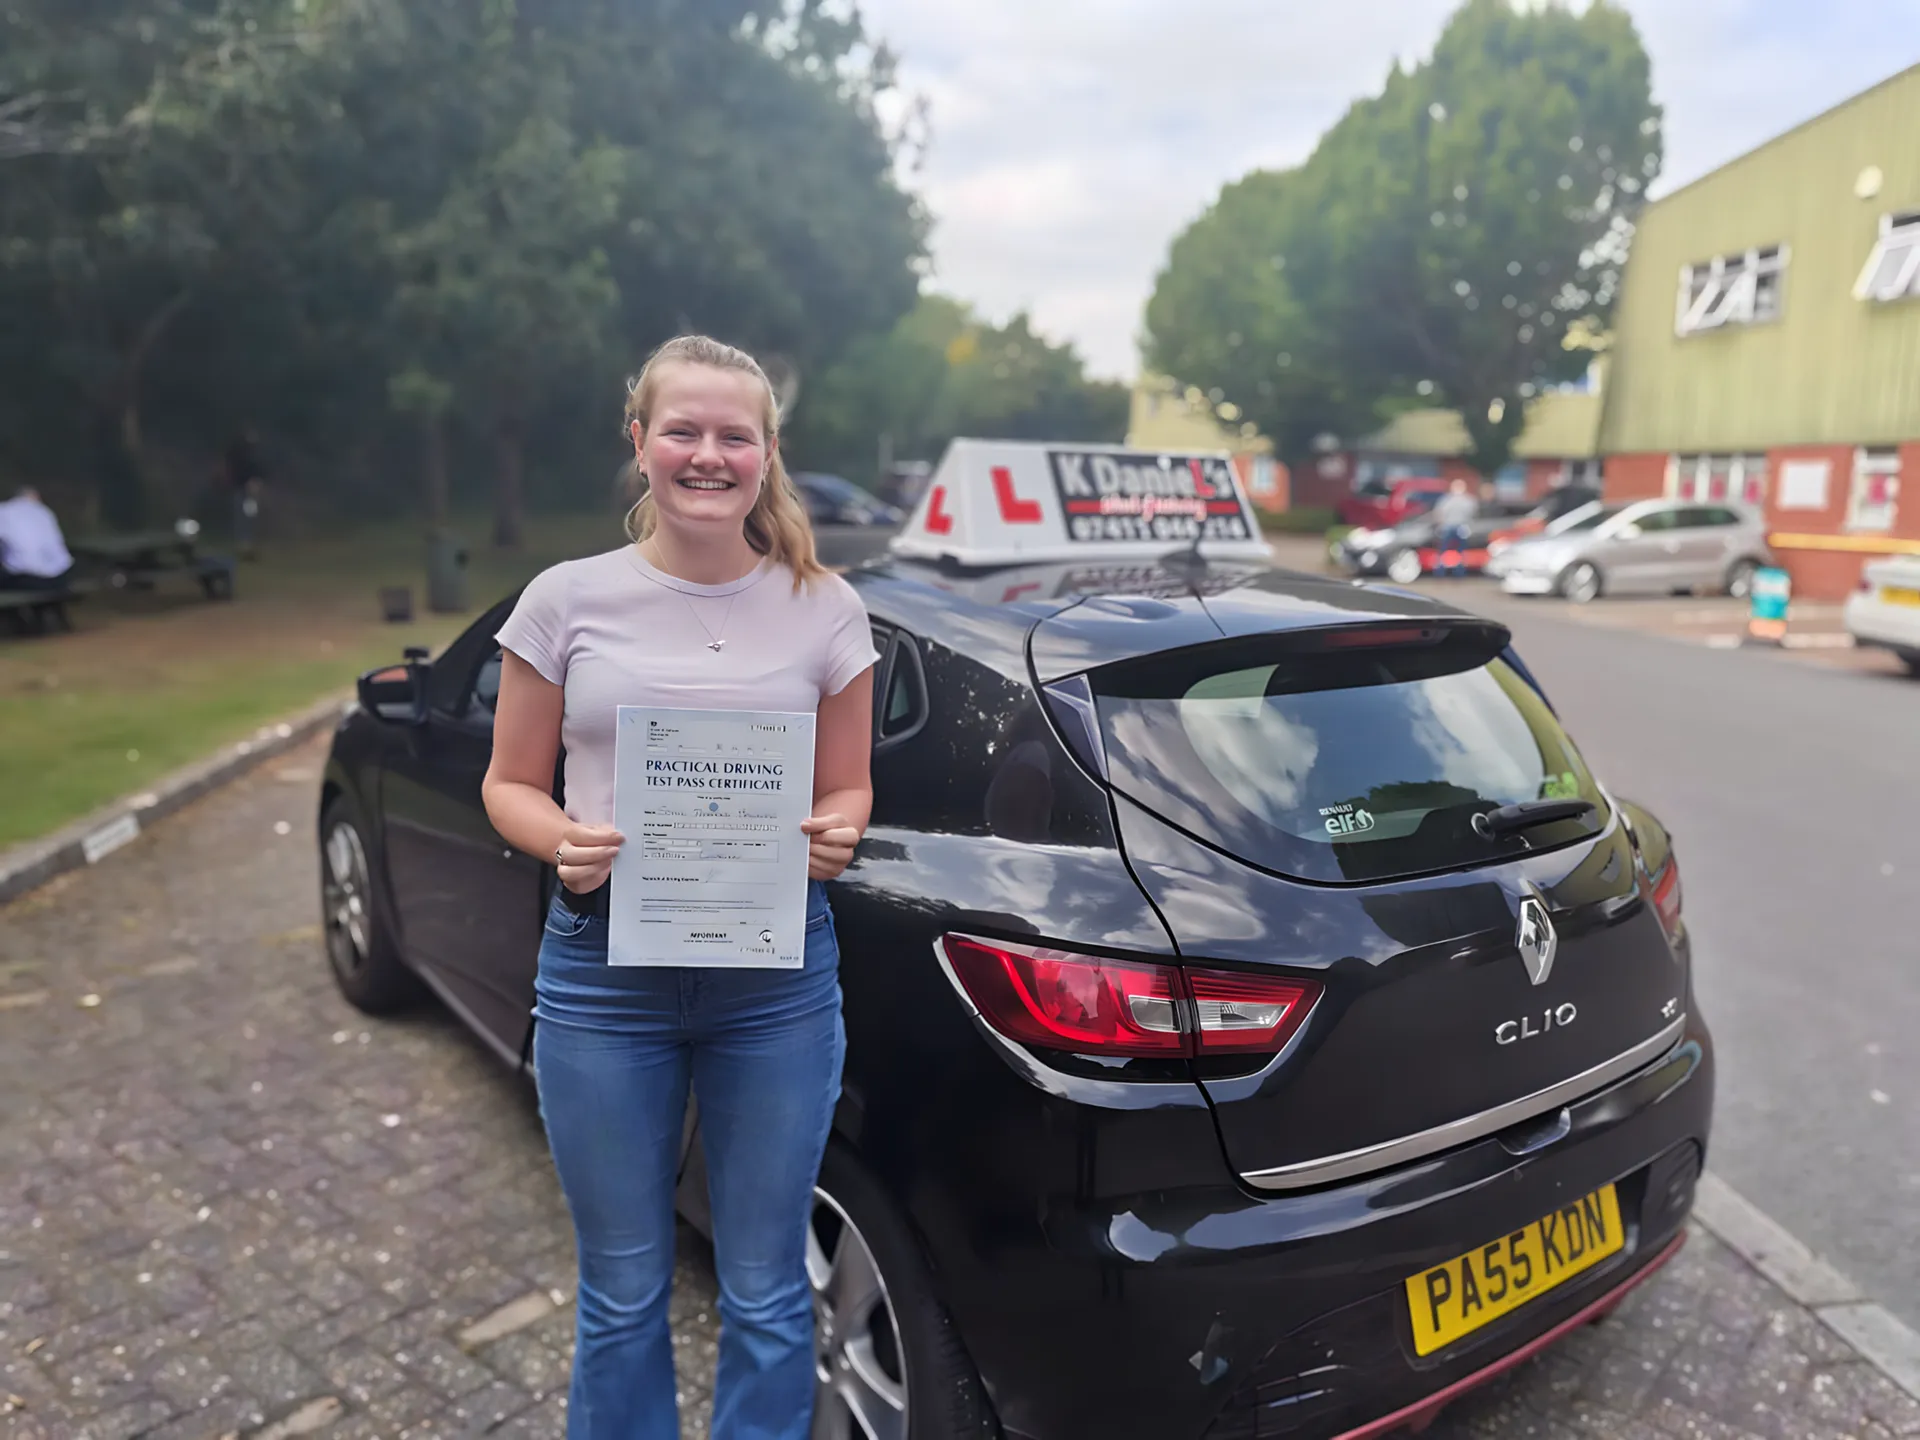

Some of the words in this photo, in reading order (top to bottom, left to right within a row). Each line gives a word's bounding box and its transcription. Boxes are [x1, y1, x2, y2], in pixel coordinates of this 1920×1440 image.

[990, 466, 1043, 524] L
[1056, 455, 1093, 497] K
[924, 485, 953, 535] L
[646, 760, 719, 773] PRACTICAL
[724, 763, 783, 776] DRIVING
[646, 776, 672, 787] TEST
[677, 777, 705, 788] PASS
[709, 778, 782, 791] CERTIFICATE
[1495, 1002, 1577, 1045] CLIO
[1425, 1230, 1532, 1333] PA55
[1538, 1191, 1606, 1275] KDN
